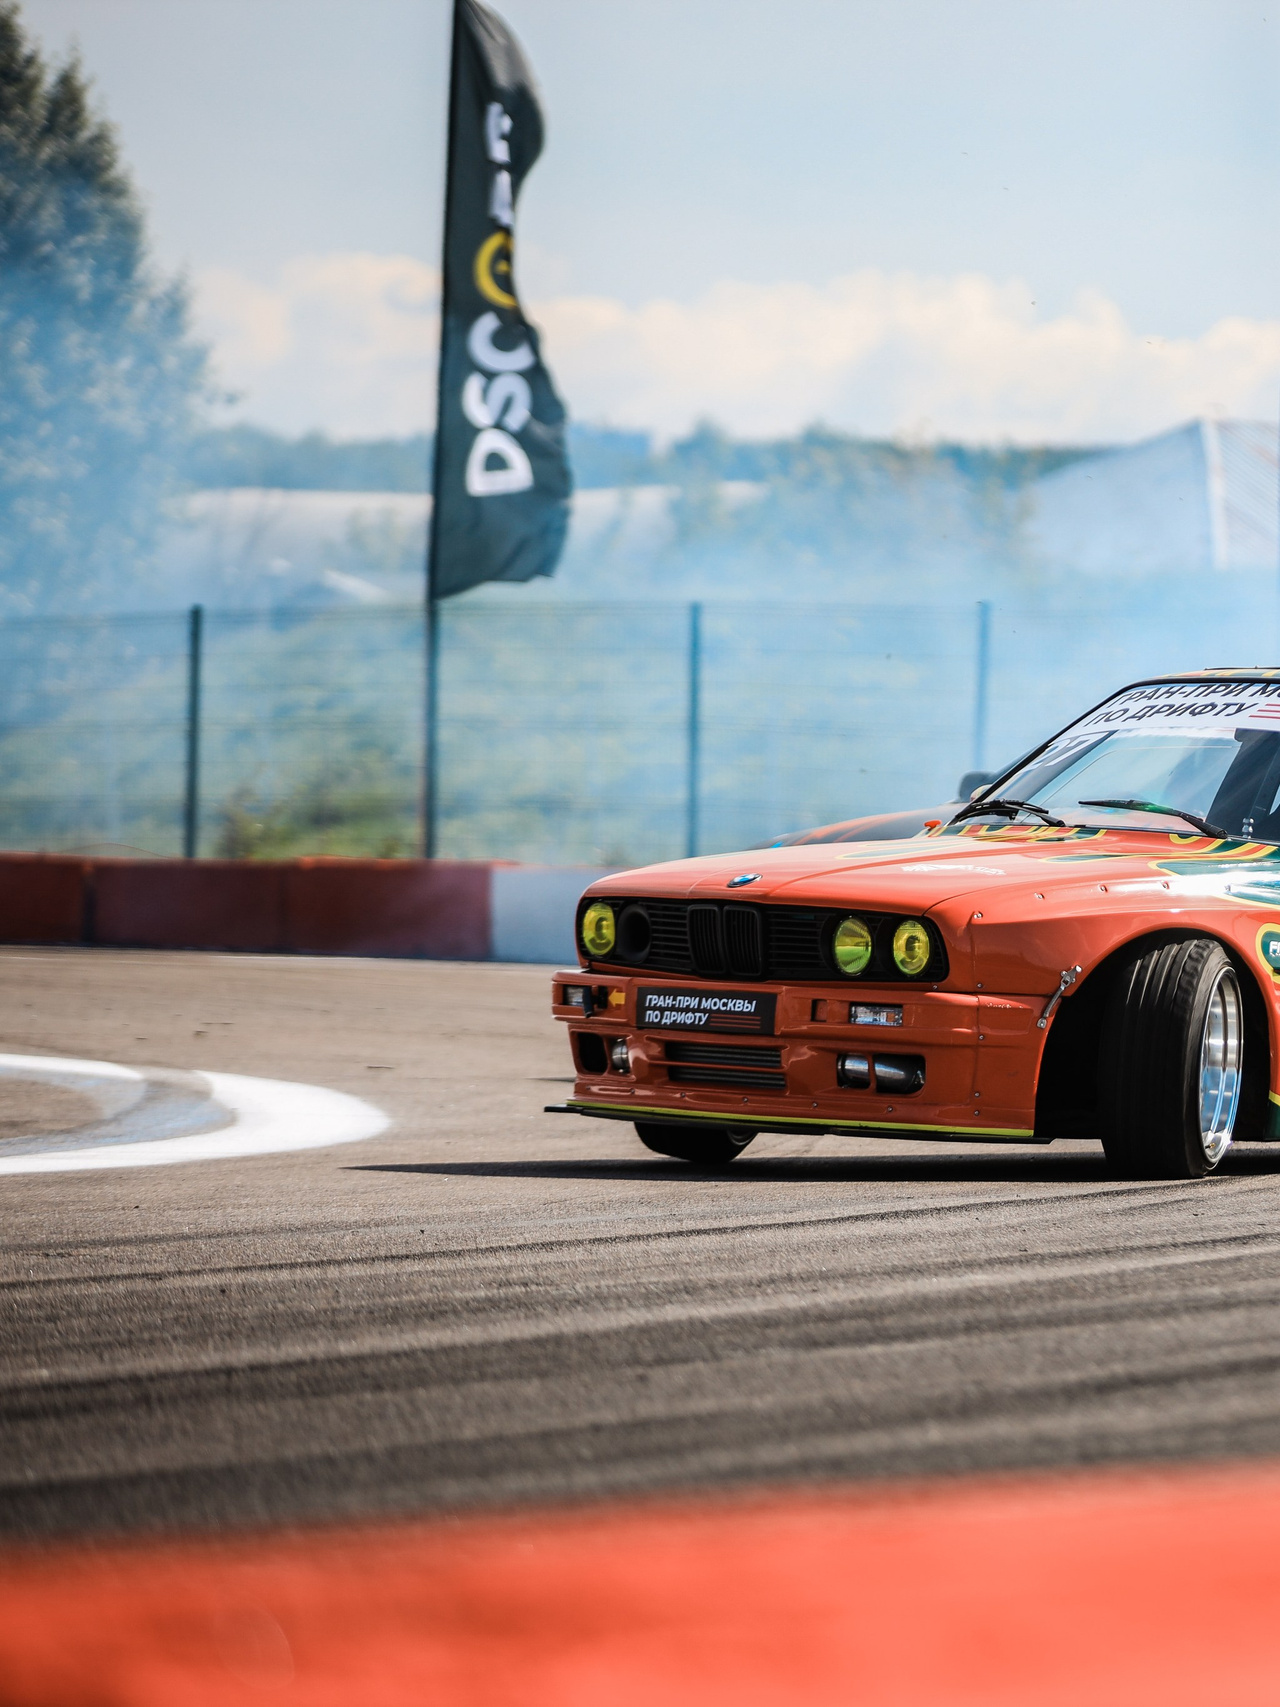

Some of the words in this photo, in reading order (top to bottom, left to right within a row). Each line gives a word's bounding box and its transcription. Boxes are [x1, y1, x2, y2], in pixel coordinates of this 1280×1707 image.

[1106, 682, 1257, 709] ГРАН-ПРИ
[1083, 707, 1130, 728] ПО
[1121, 701, 1259, 724] ДРИФТУ
[645, 995, 699, 1009] ГРАН-ПРИ
[700, 997, 756, 1012] МОСКВЫ
[645, 1010, 661, 1022] ПО
[661, 1011, 708, 1025] ДРИФТУ
